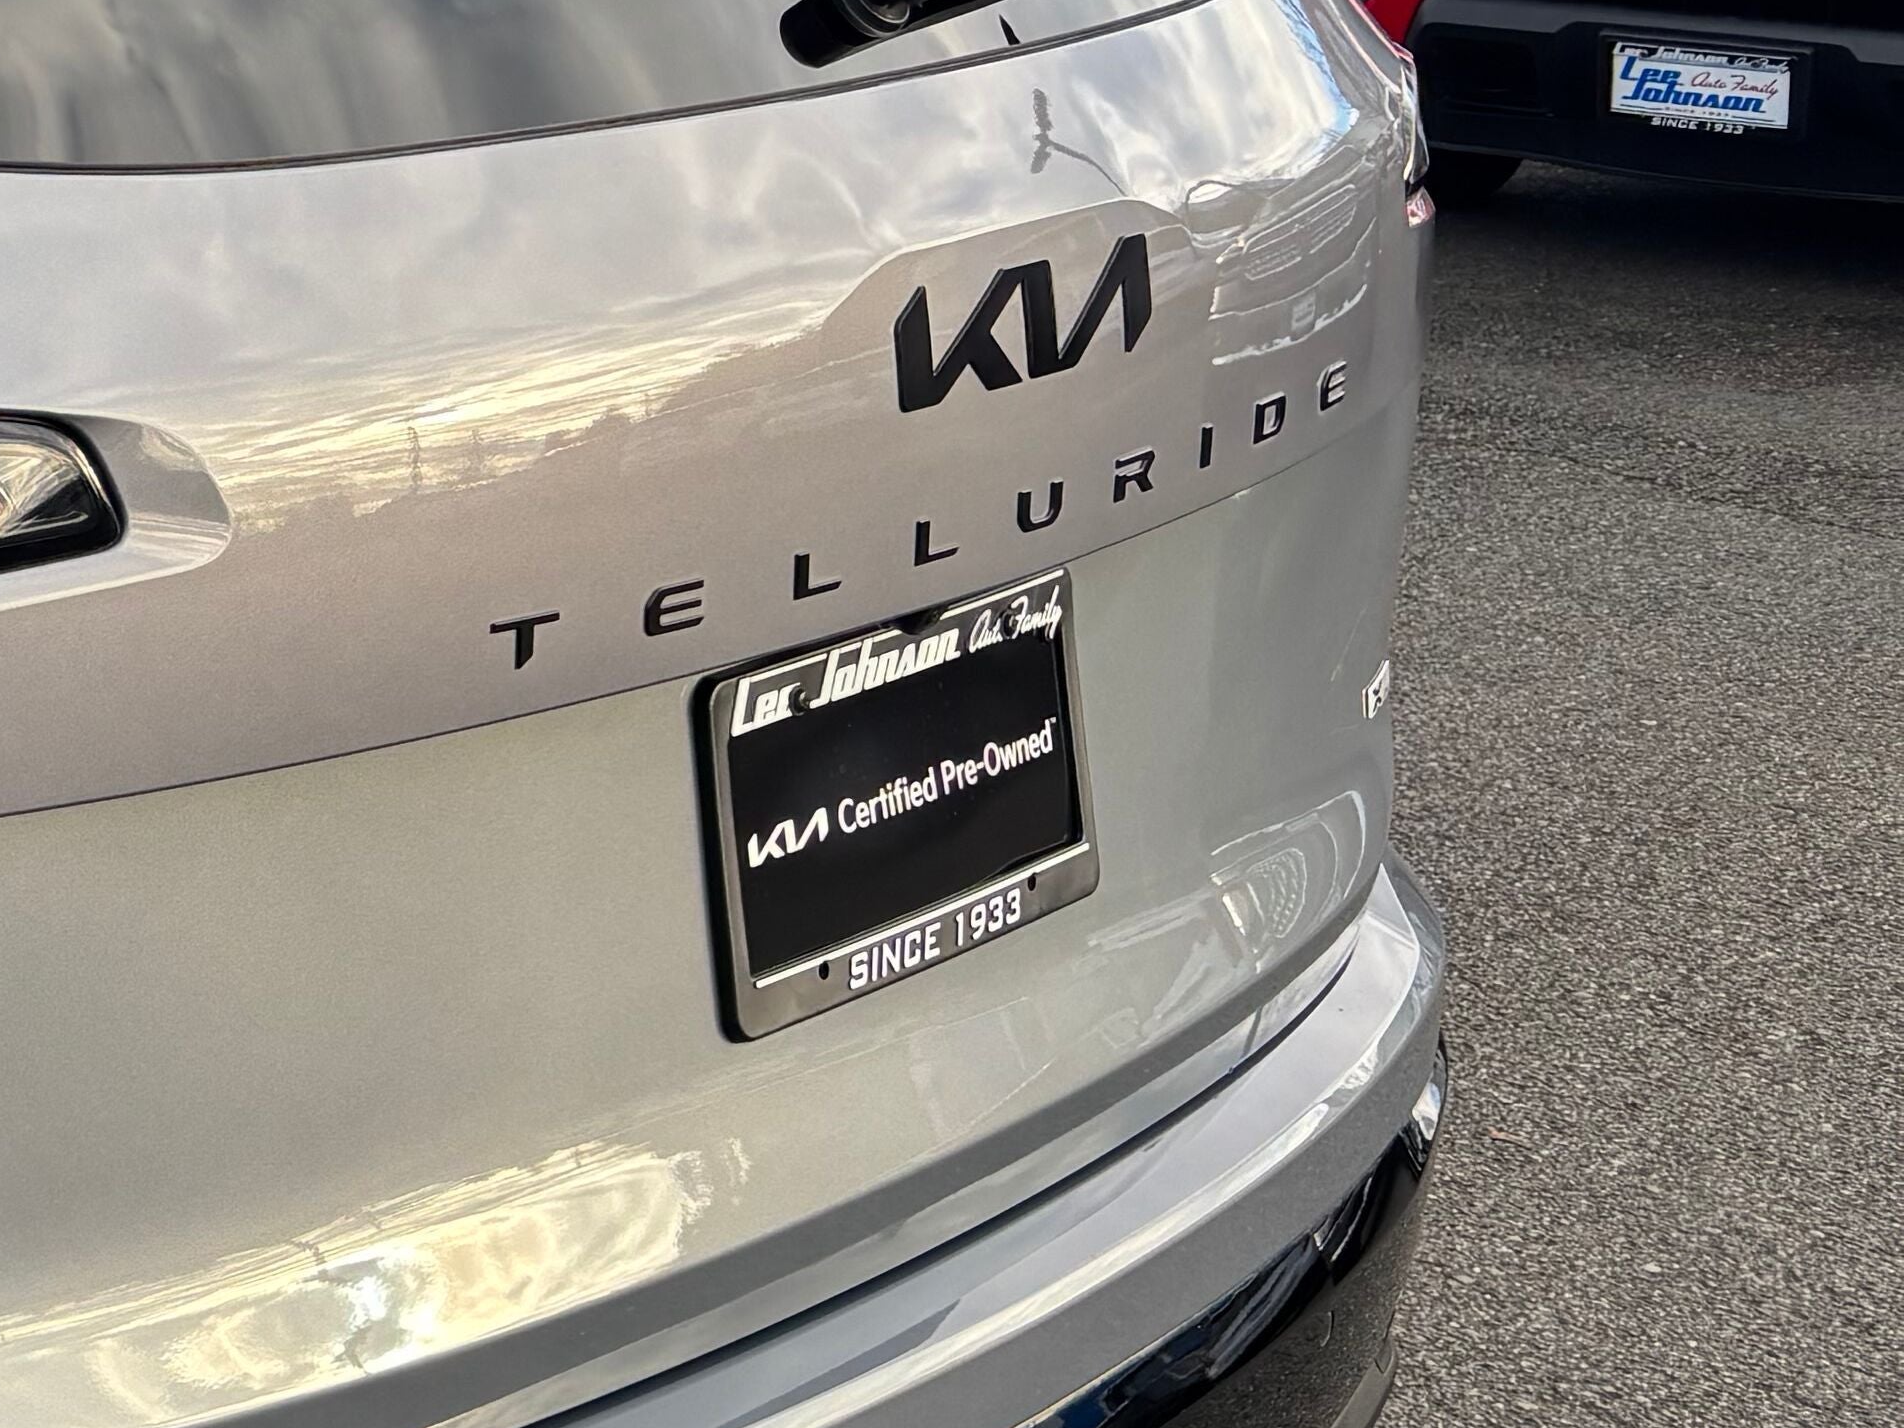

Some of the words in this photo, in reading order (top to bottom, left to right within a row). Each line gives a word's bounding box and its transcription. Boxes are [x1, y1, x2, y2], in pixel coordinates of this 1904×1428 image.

[1620, 56, 1682, 85] Lee
[1691, 71, 1726, 89] Auto
[1730, 74, 1779, 100] Family
[1621, 78, 1767, 113] Johnson
[1651, 116, 1699, 130] SINCE
[1704, 121, 1745, 135] 1933
[893, 233, 1152, 413] KIA
[489, 361, 1348, 669] TELLURIDE
[809, 627, 961, 709] Johnson
[1010, 584, 1063, 639] Family
[747, 806, 829, 868] KIA
[837, 766, 938, 834] Certified
[848, 922, 941, 990] SINCE
[955, 887, 1022, 948] 1933
